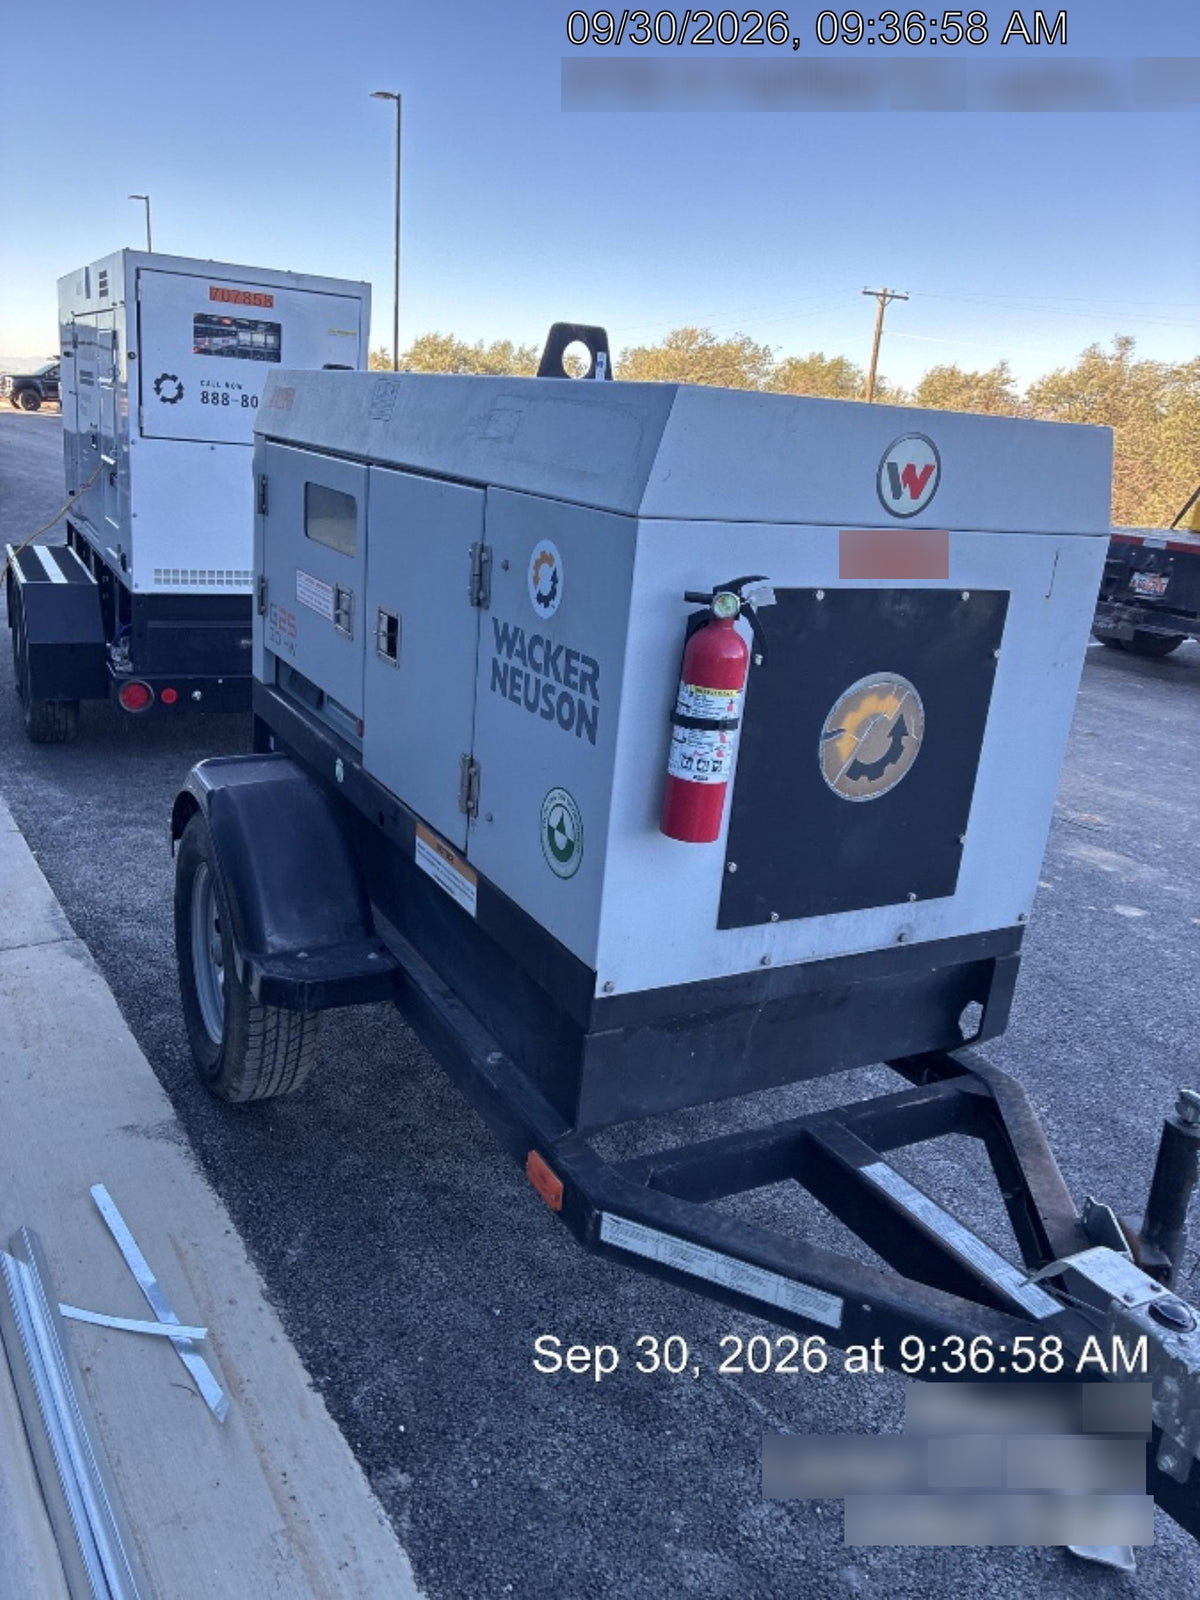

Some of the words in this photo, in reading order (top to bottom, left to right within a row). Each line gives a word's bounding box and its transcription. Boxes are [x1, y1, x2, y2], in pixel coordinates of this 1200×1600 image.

[200, 380, 221, 388] CALL
[490, 656, 600, 747] NEUSON
[491, 616, 600, 702] WACKER
